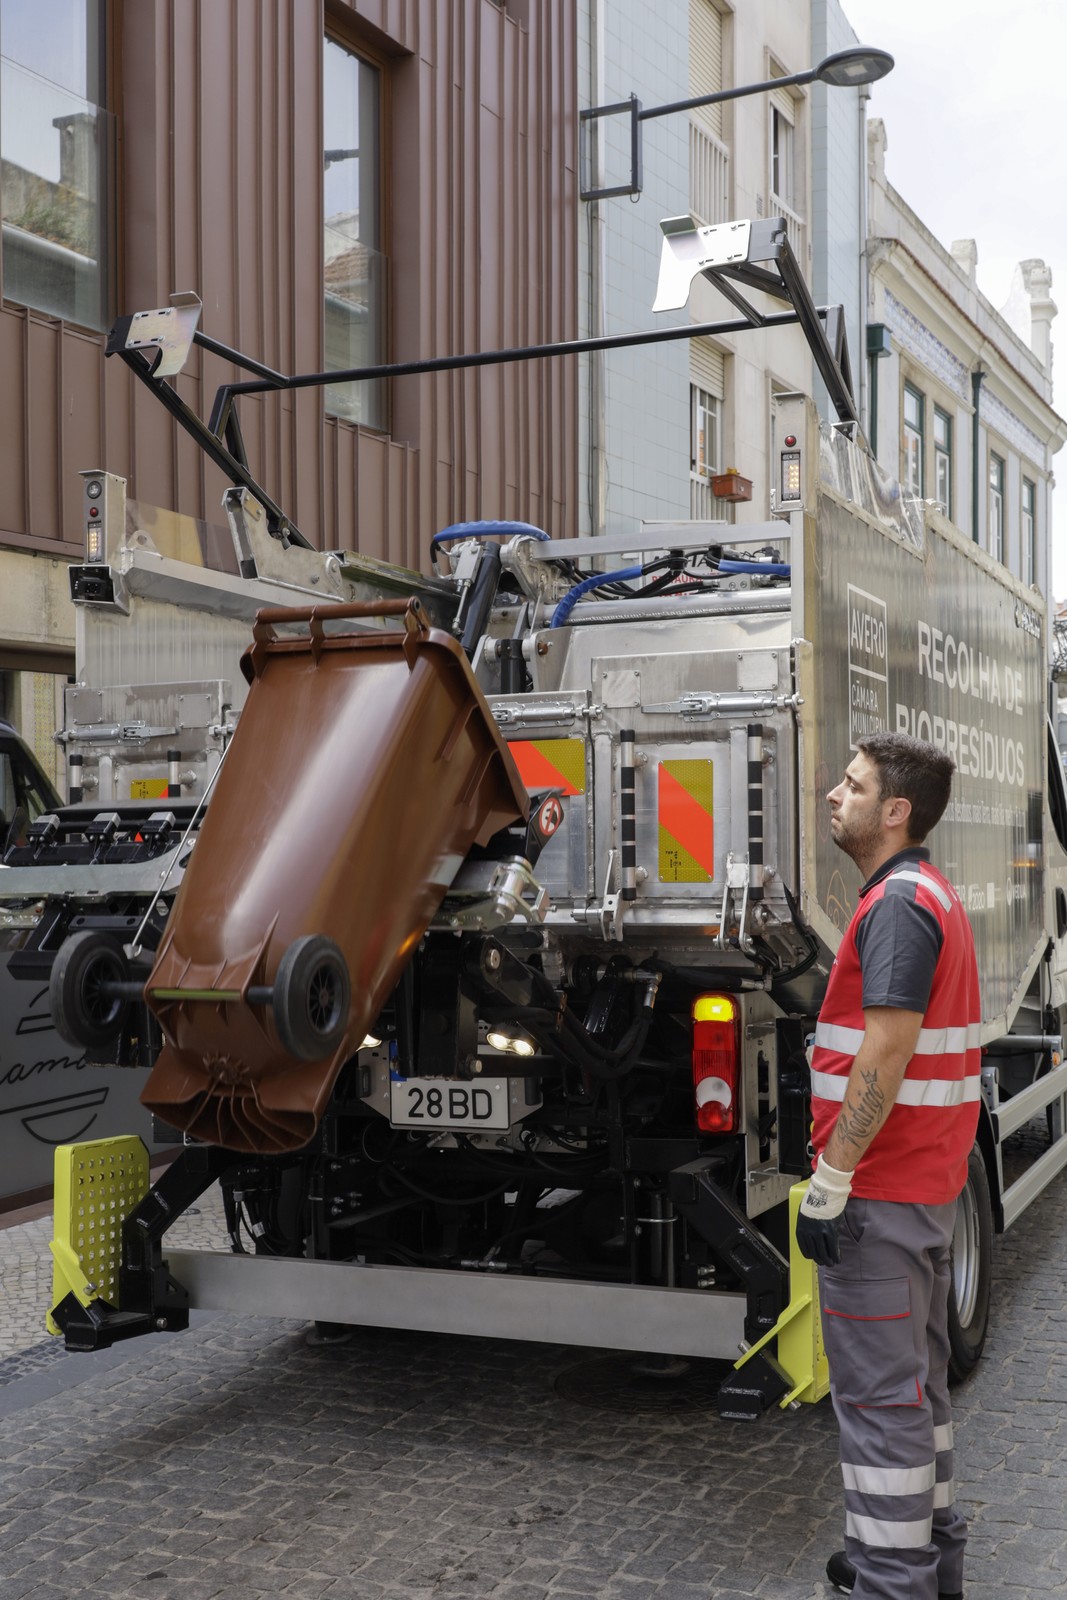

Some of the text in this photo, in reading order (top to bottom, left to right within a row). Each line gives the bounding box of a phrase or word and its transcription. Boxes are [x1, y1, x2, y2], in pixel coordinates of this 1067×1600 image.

[851, 608, 885, 659] AVEIRO
[918, 620, 1002, 707] RECOLHA
[1005, 665, 1023, 716] DE
[408, 1087, 493, 1120] 28 BD
